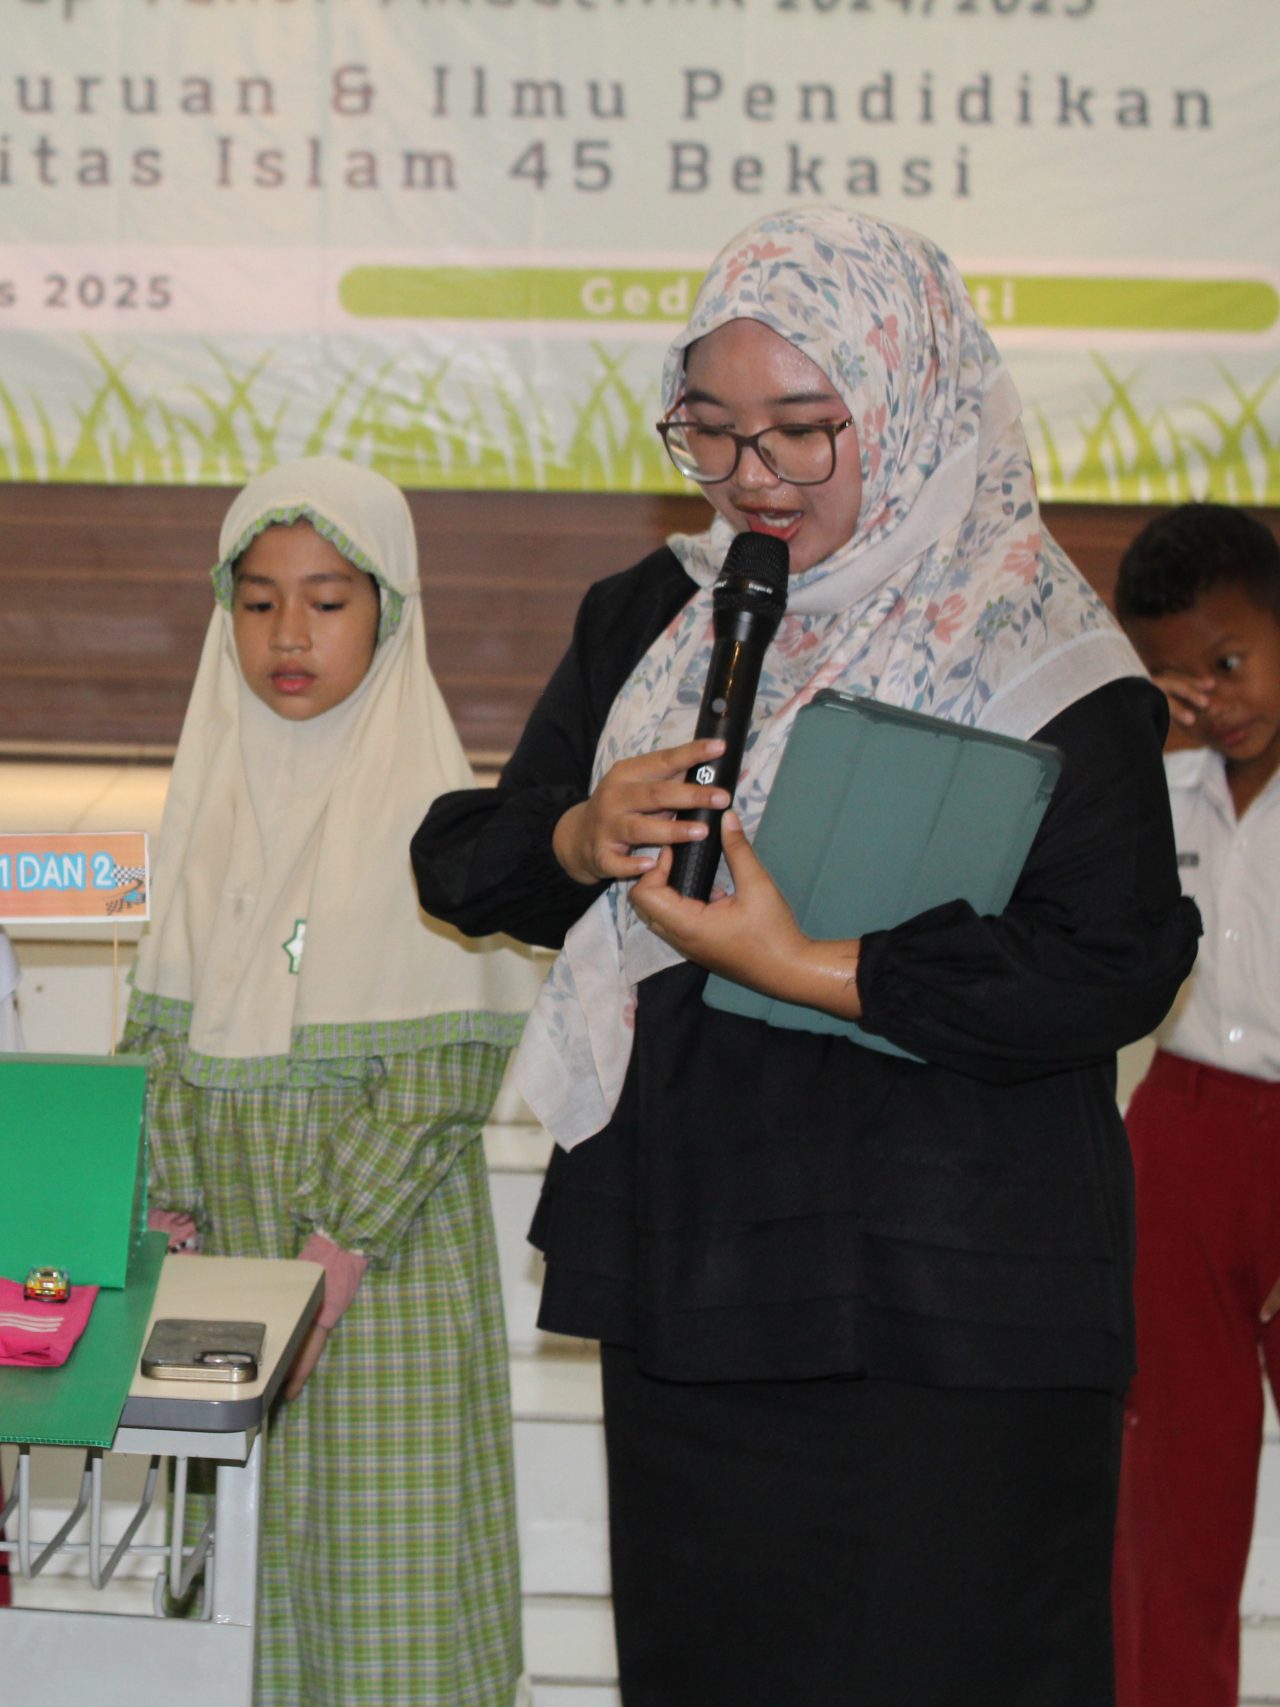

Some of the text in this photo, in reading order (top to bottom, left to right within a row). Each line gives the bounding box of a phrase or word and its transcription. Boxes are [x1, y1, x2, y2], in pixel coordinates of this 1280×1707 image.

[331, 66, 376, 118] &
[430, 67, 627, 120] Ilmu
[682, 70, 1212, 128] Pendidikan
[214, 137, 458, 190] Islam
[508, 141, 614, 193] 45
[669, 143, 972, 197] Bekasi
[43, 273, 173, 310] 2025
[581, 277, 689, 316] Ged
[18, 853, 84, 888] DAN
[92, 854, 114, 887] 2
